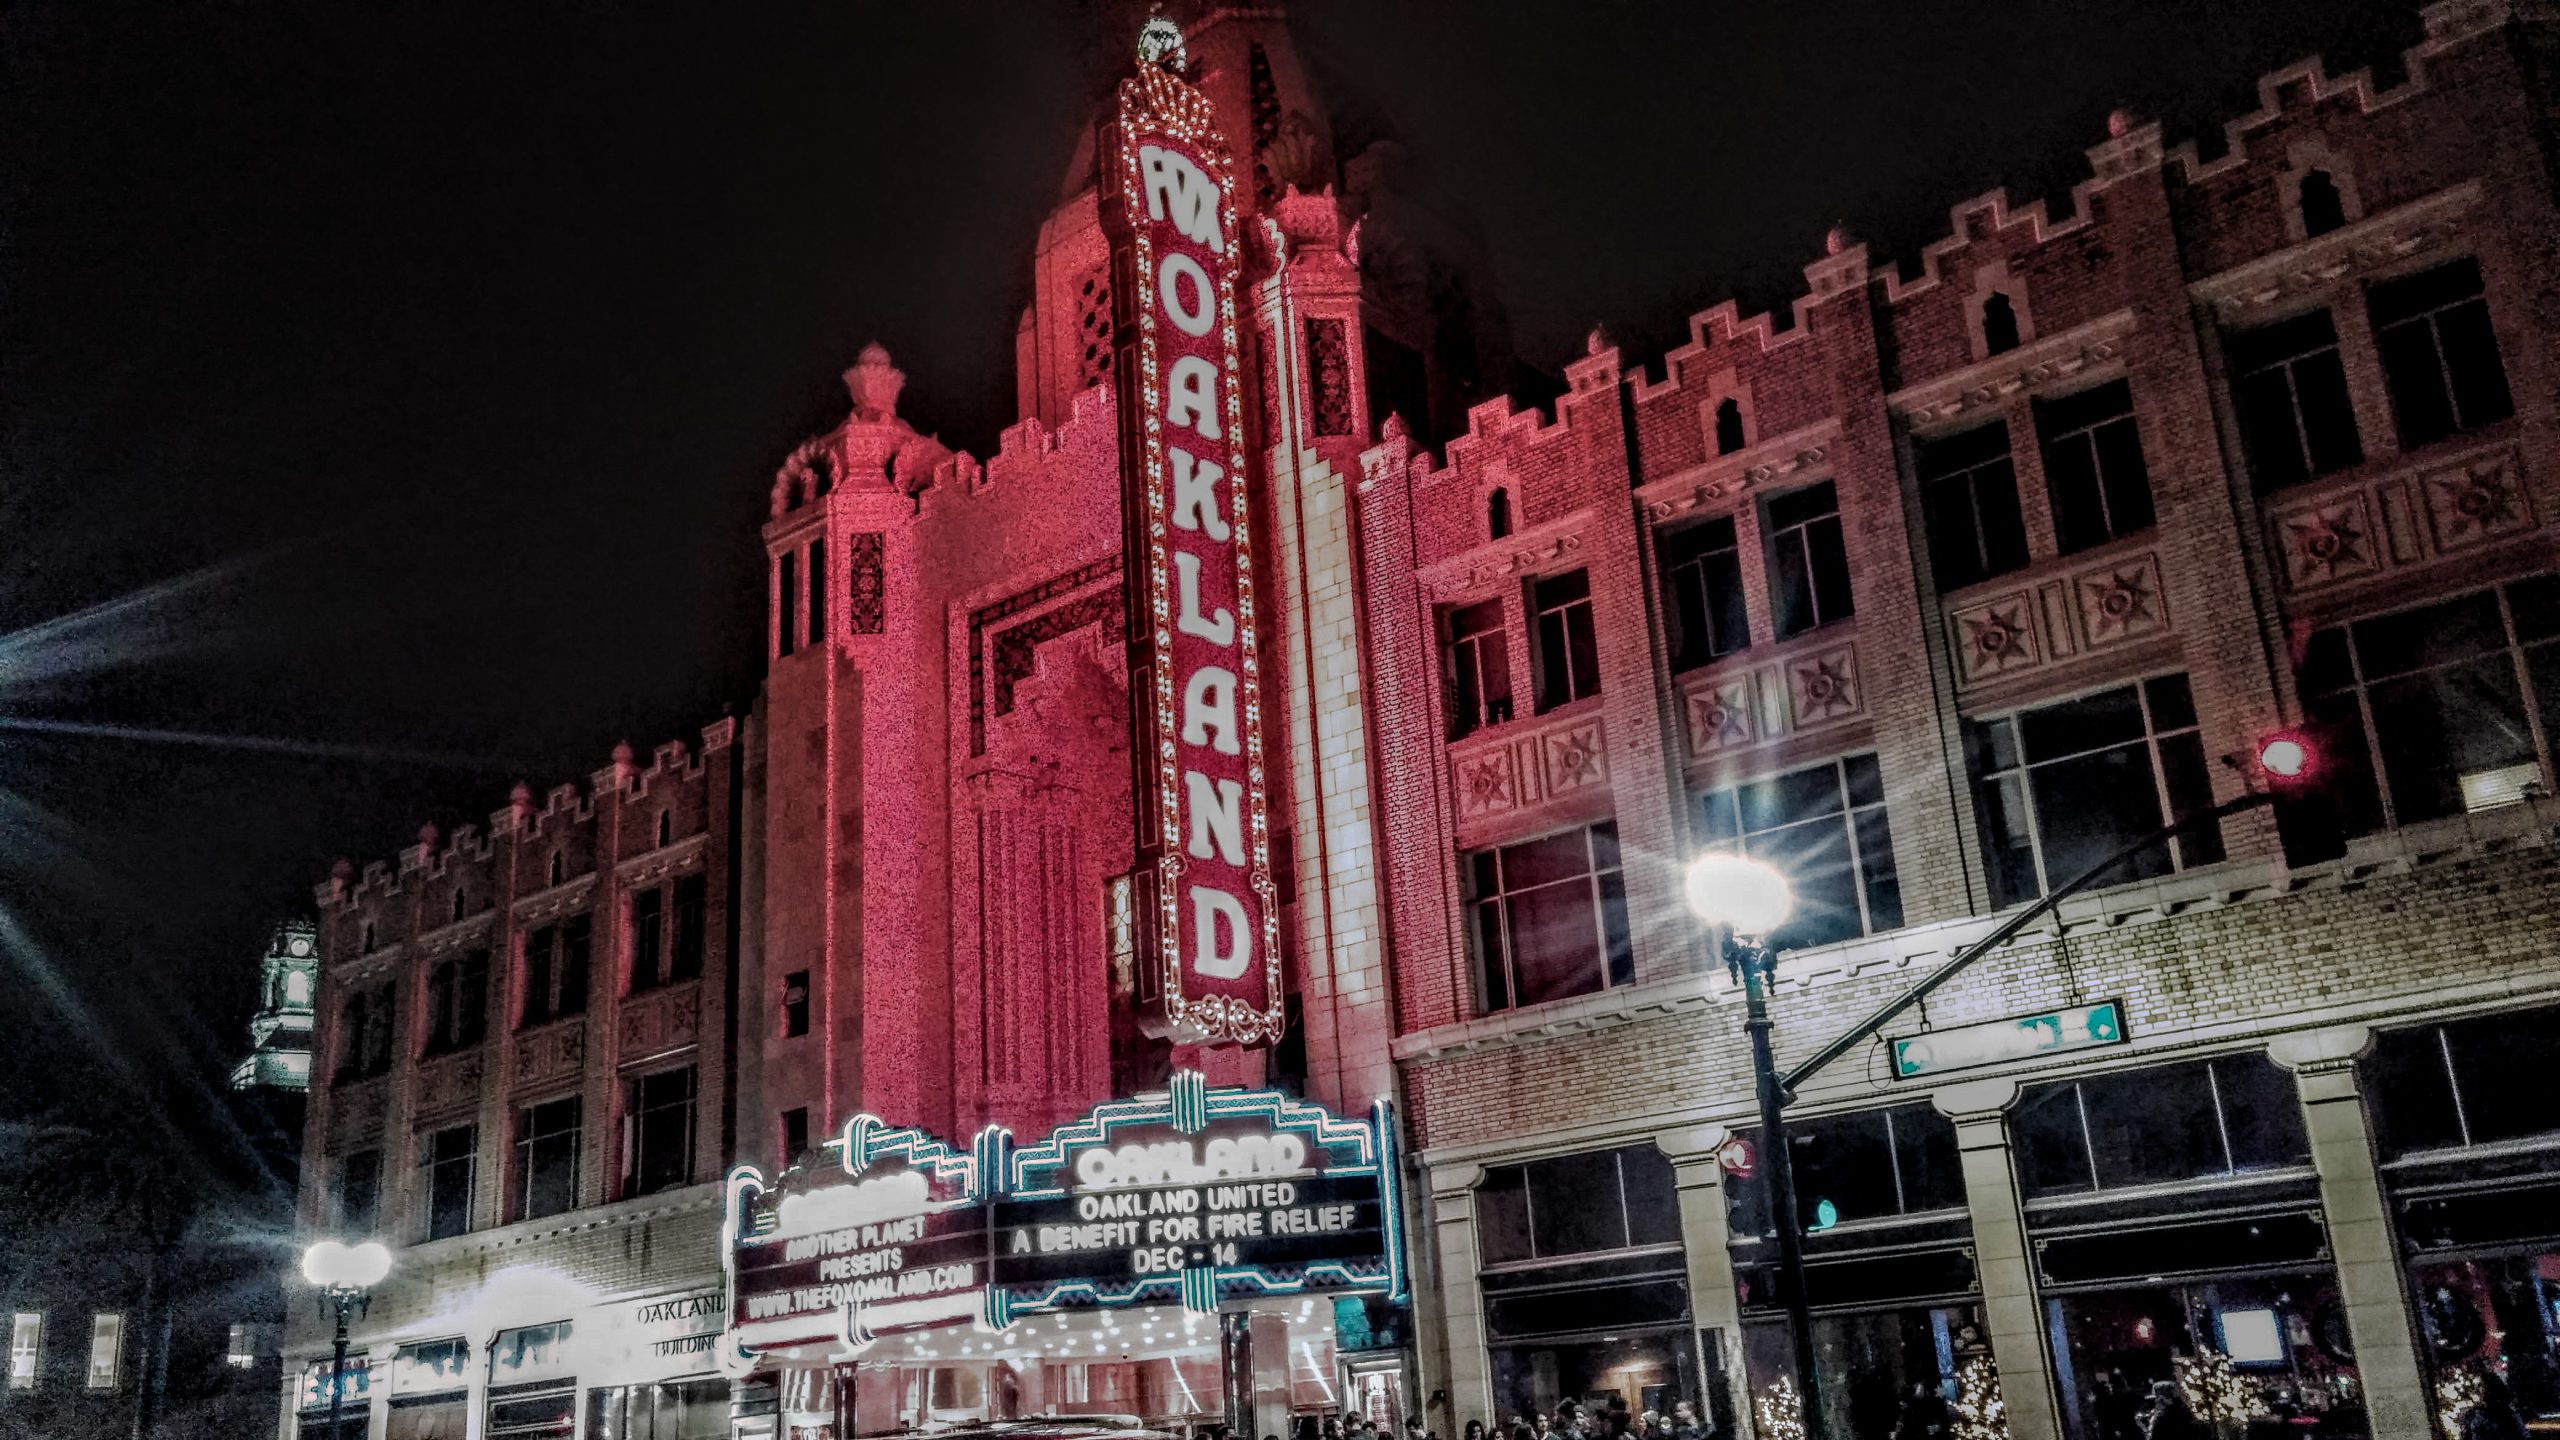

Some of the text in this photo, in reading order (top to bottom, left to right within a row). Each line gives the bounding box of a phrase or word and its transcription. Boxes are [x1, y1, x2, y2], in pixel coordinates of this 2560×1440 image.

[1139, 145, 1225, 253] FOX
[1158, 252, 1254, 981] OAKLAND
[1077, 1133, 1305, 1187] OAKLAND
[1079, 1182, 1295, 1221] OAKLAND UNITED
[785, 1215, 926, 1262] ANOTHER PLANET
[1013, 1205, 1355, 1254] A BENEFIT FOR FIRE RELIEF
[820, 1247, 903, 1282] PRESENTS
[1134, 1246, 1185, 1273] DEC
[1212, 1242, 1237, 1266] 14
[637, 1294, 726, 1324] OAKLAND
[748, 1263, 974, 1320] WWW.THEFOXOAKLAND.COM
